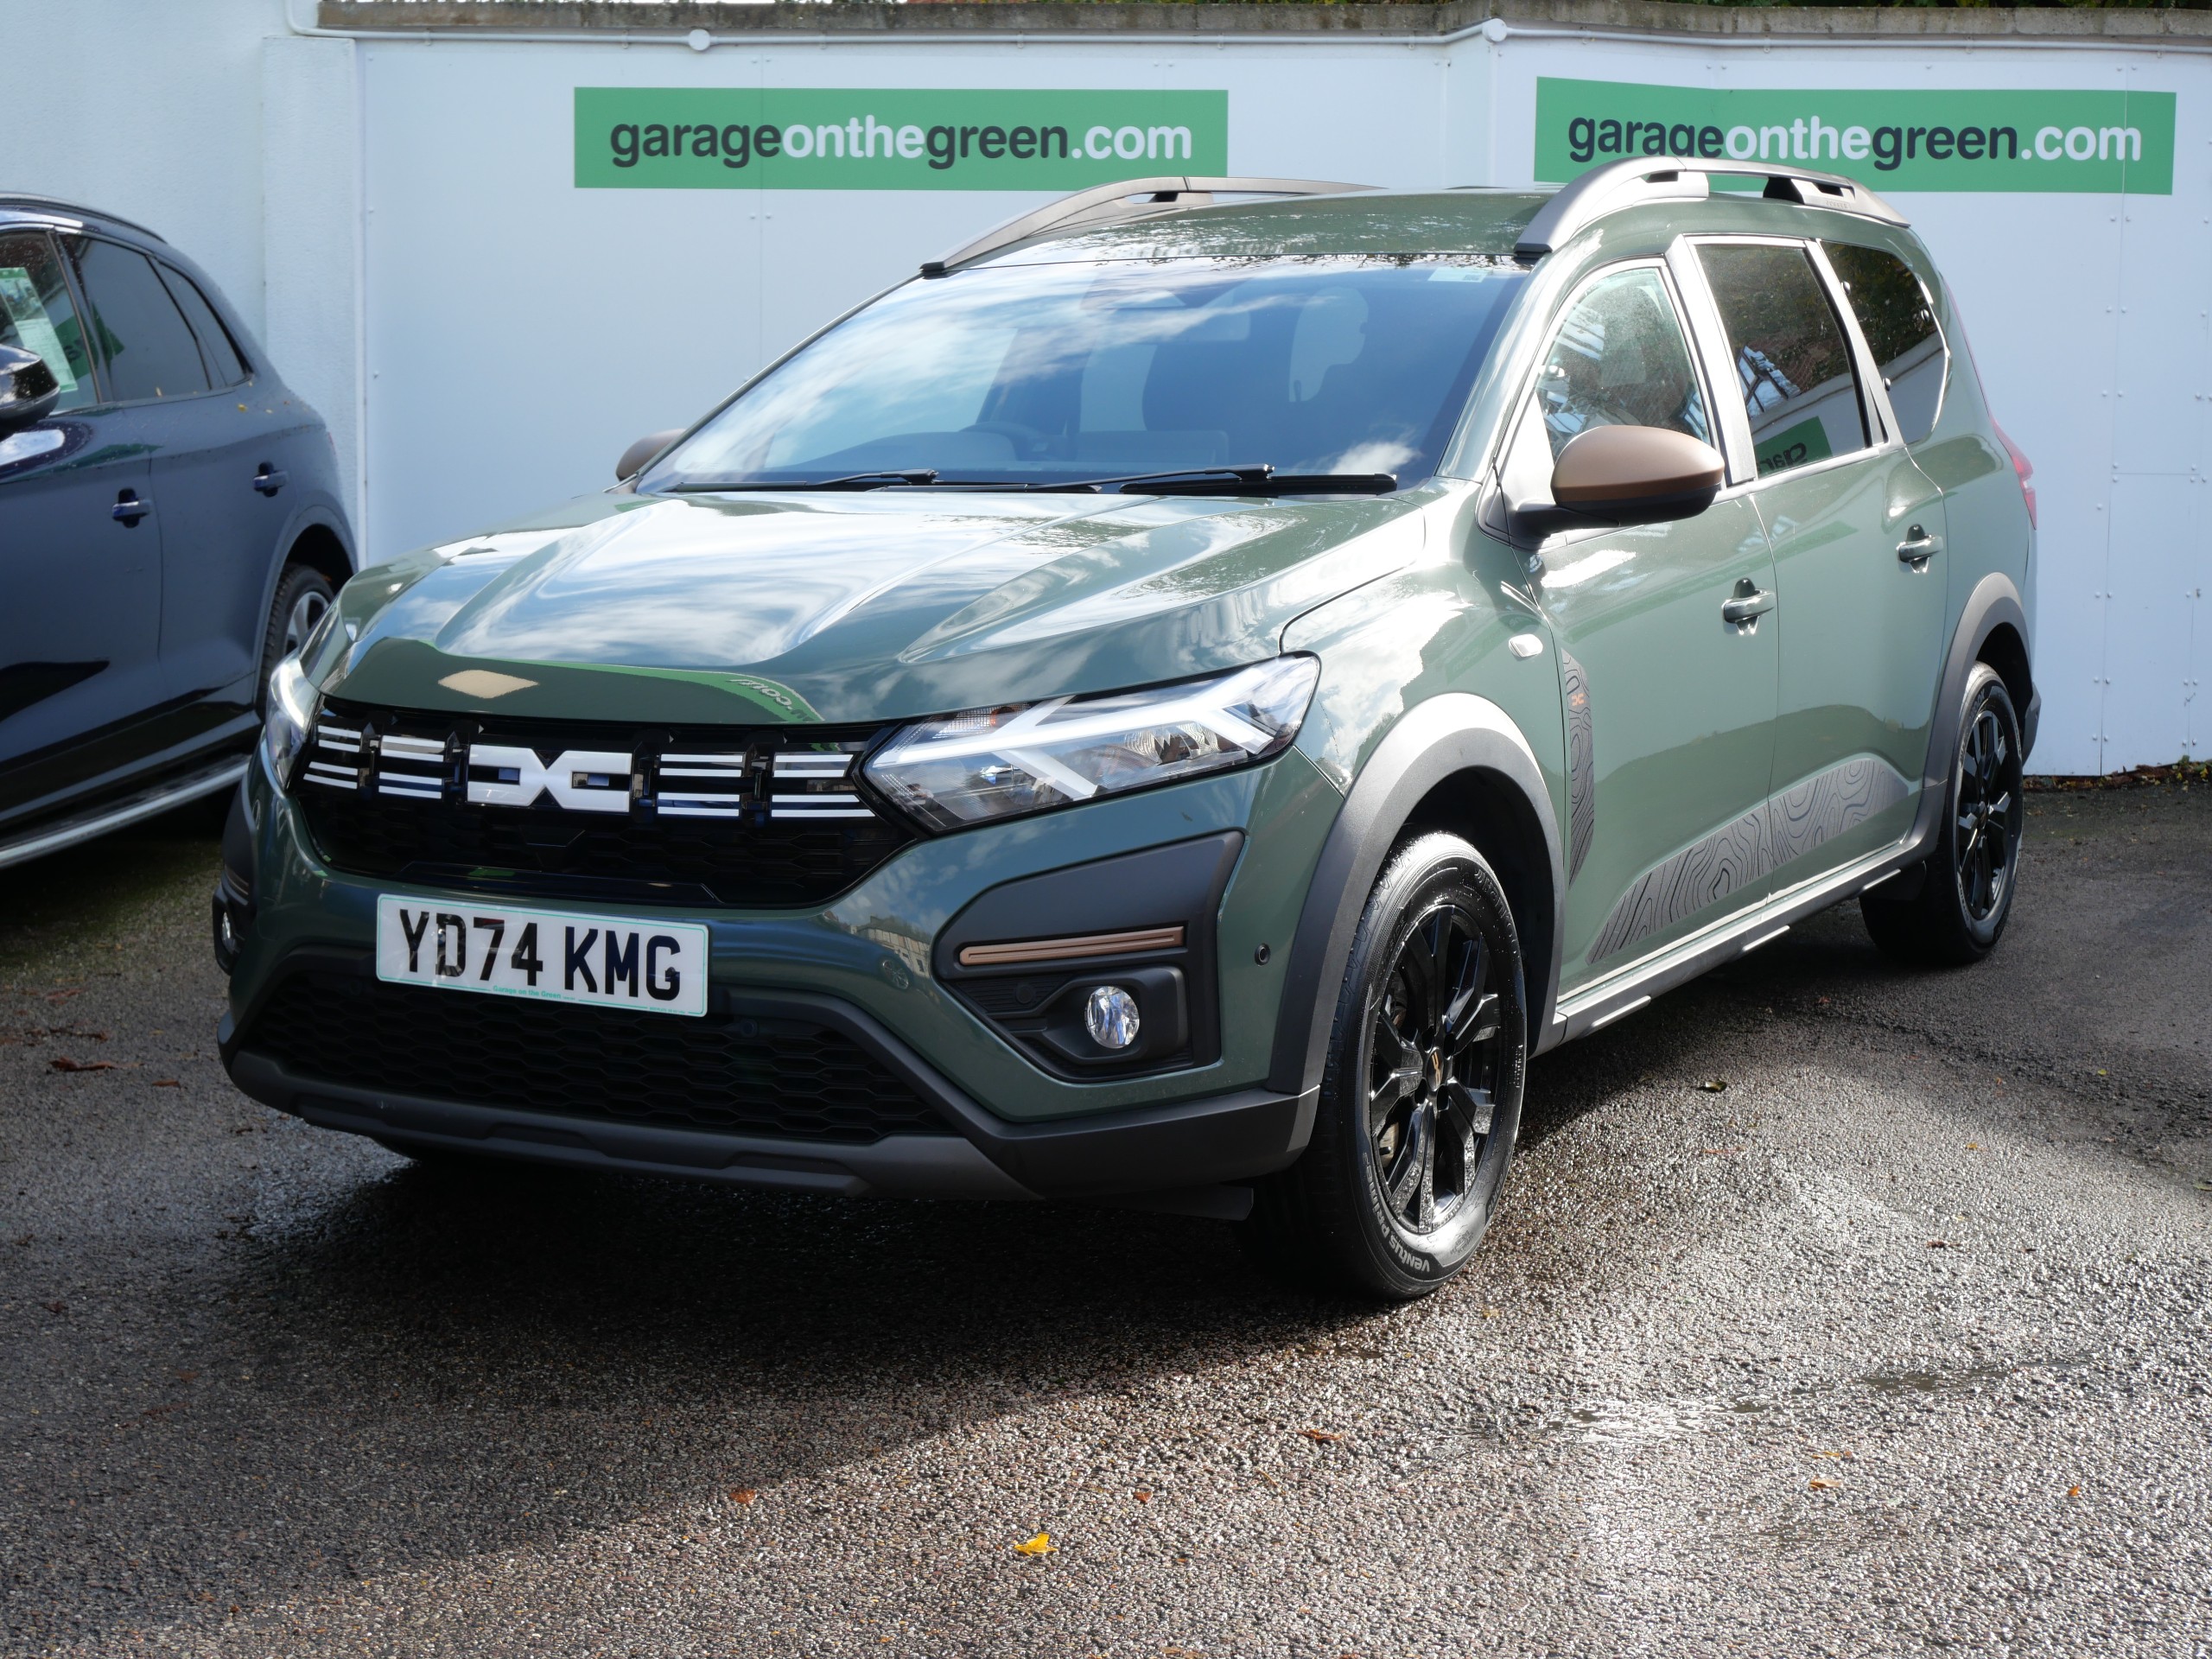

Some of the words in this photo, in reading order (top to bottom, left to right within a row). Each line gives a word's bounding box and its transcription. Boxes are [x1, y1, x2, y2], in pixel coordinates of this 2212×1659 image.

[610, 115, 1192, 169] garageonthegreen.com
[1568, 116, 2142, 170] garageonthegreen.com
[399, 908, 543, 987] YD74
[564, 925, 681, 1001] KMG
[493, 985, 517, 994] Garage
[541, 990, 562, 999] Green
